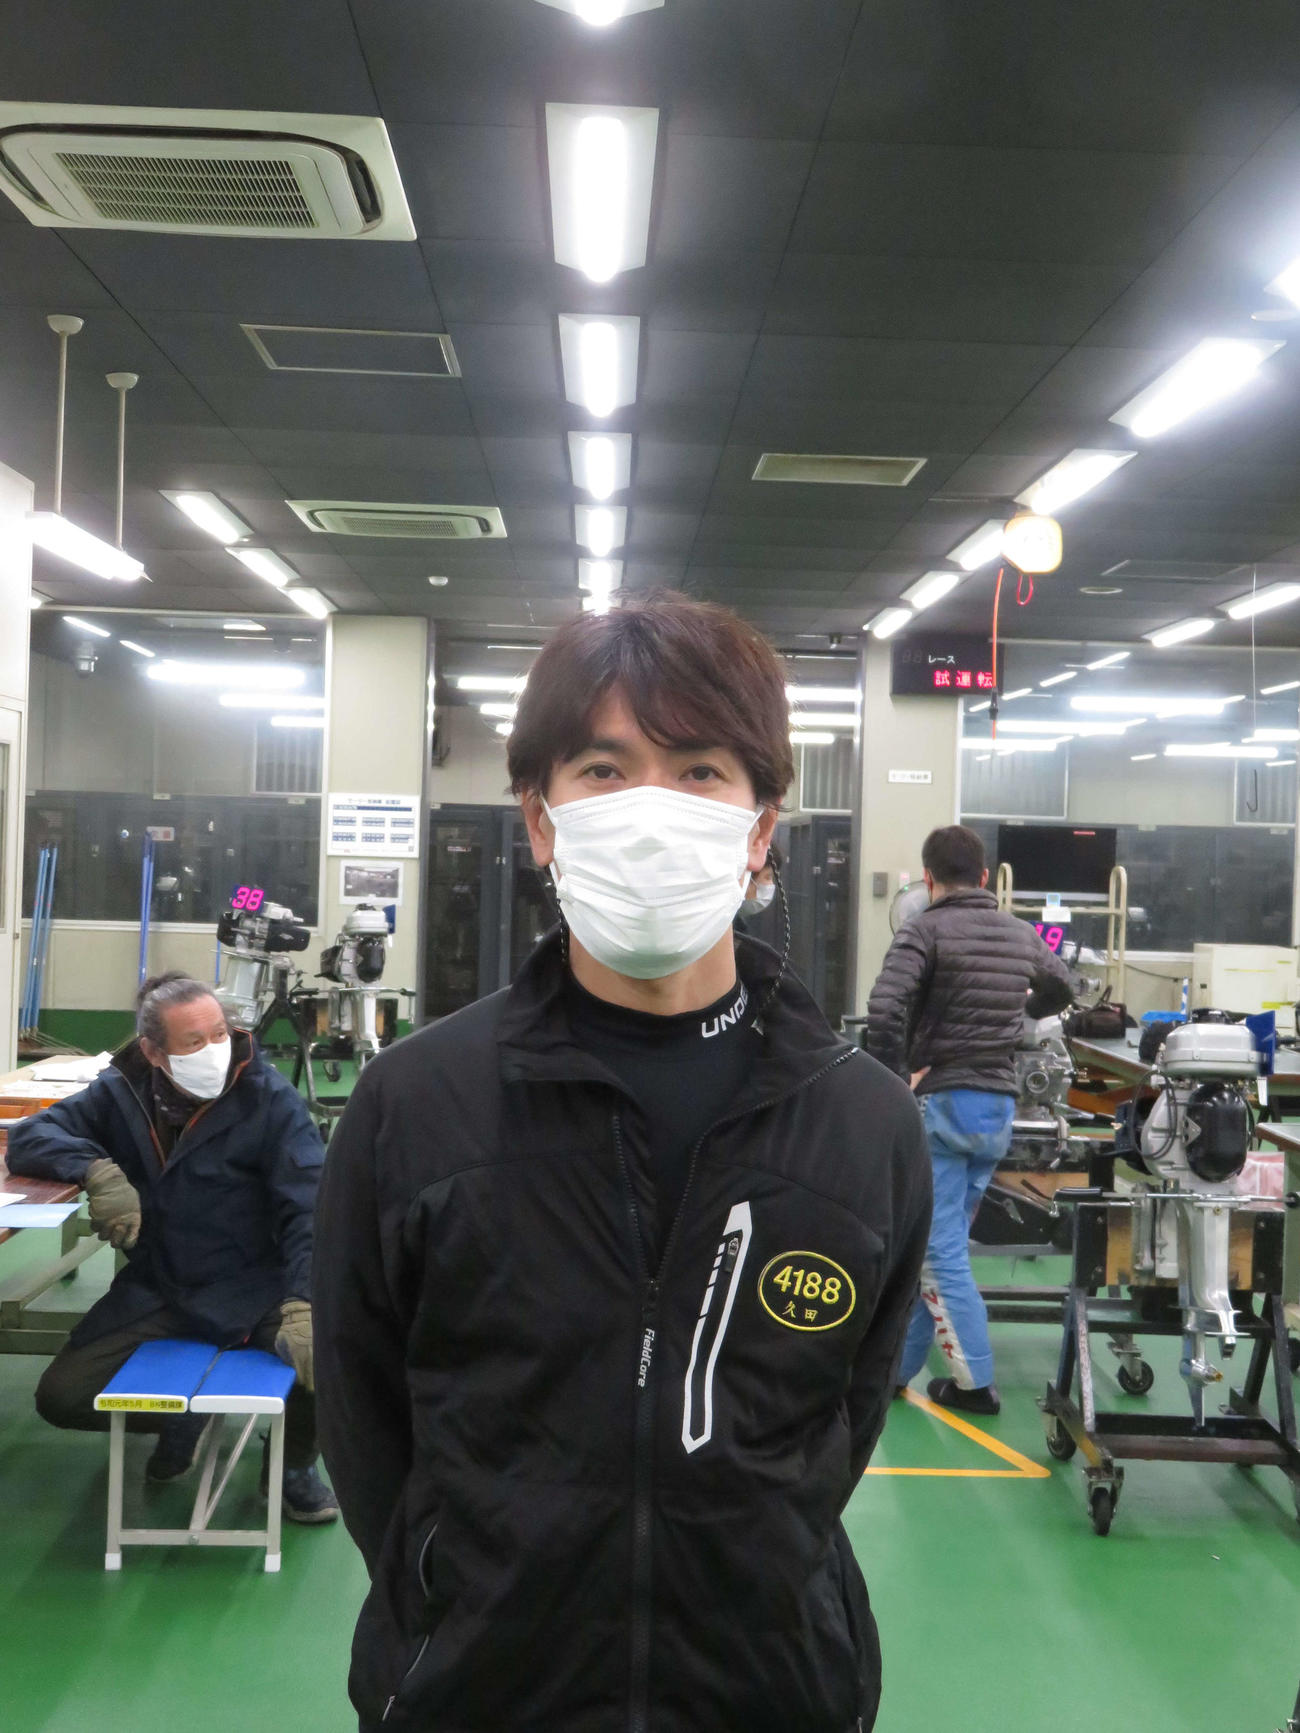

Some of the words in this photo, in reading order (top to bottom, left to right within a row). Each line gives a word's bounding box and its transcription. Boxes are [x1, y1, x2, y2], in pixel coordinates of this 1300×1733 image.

[928, 655, 956, 664] レース
[934, 670, 993, 688] 試運転
[232, 887, 264, 911] 38
[773, 1265, 841, 1304] 4188
[782, 1300, 818, 1322] 久田
[638, 1328, 655, 1387] FieldCore
